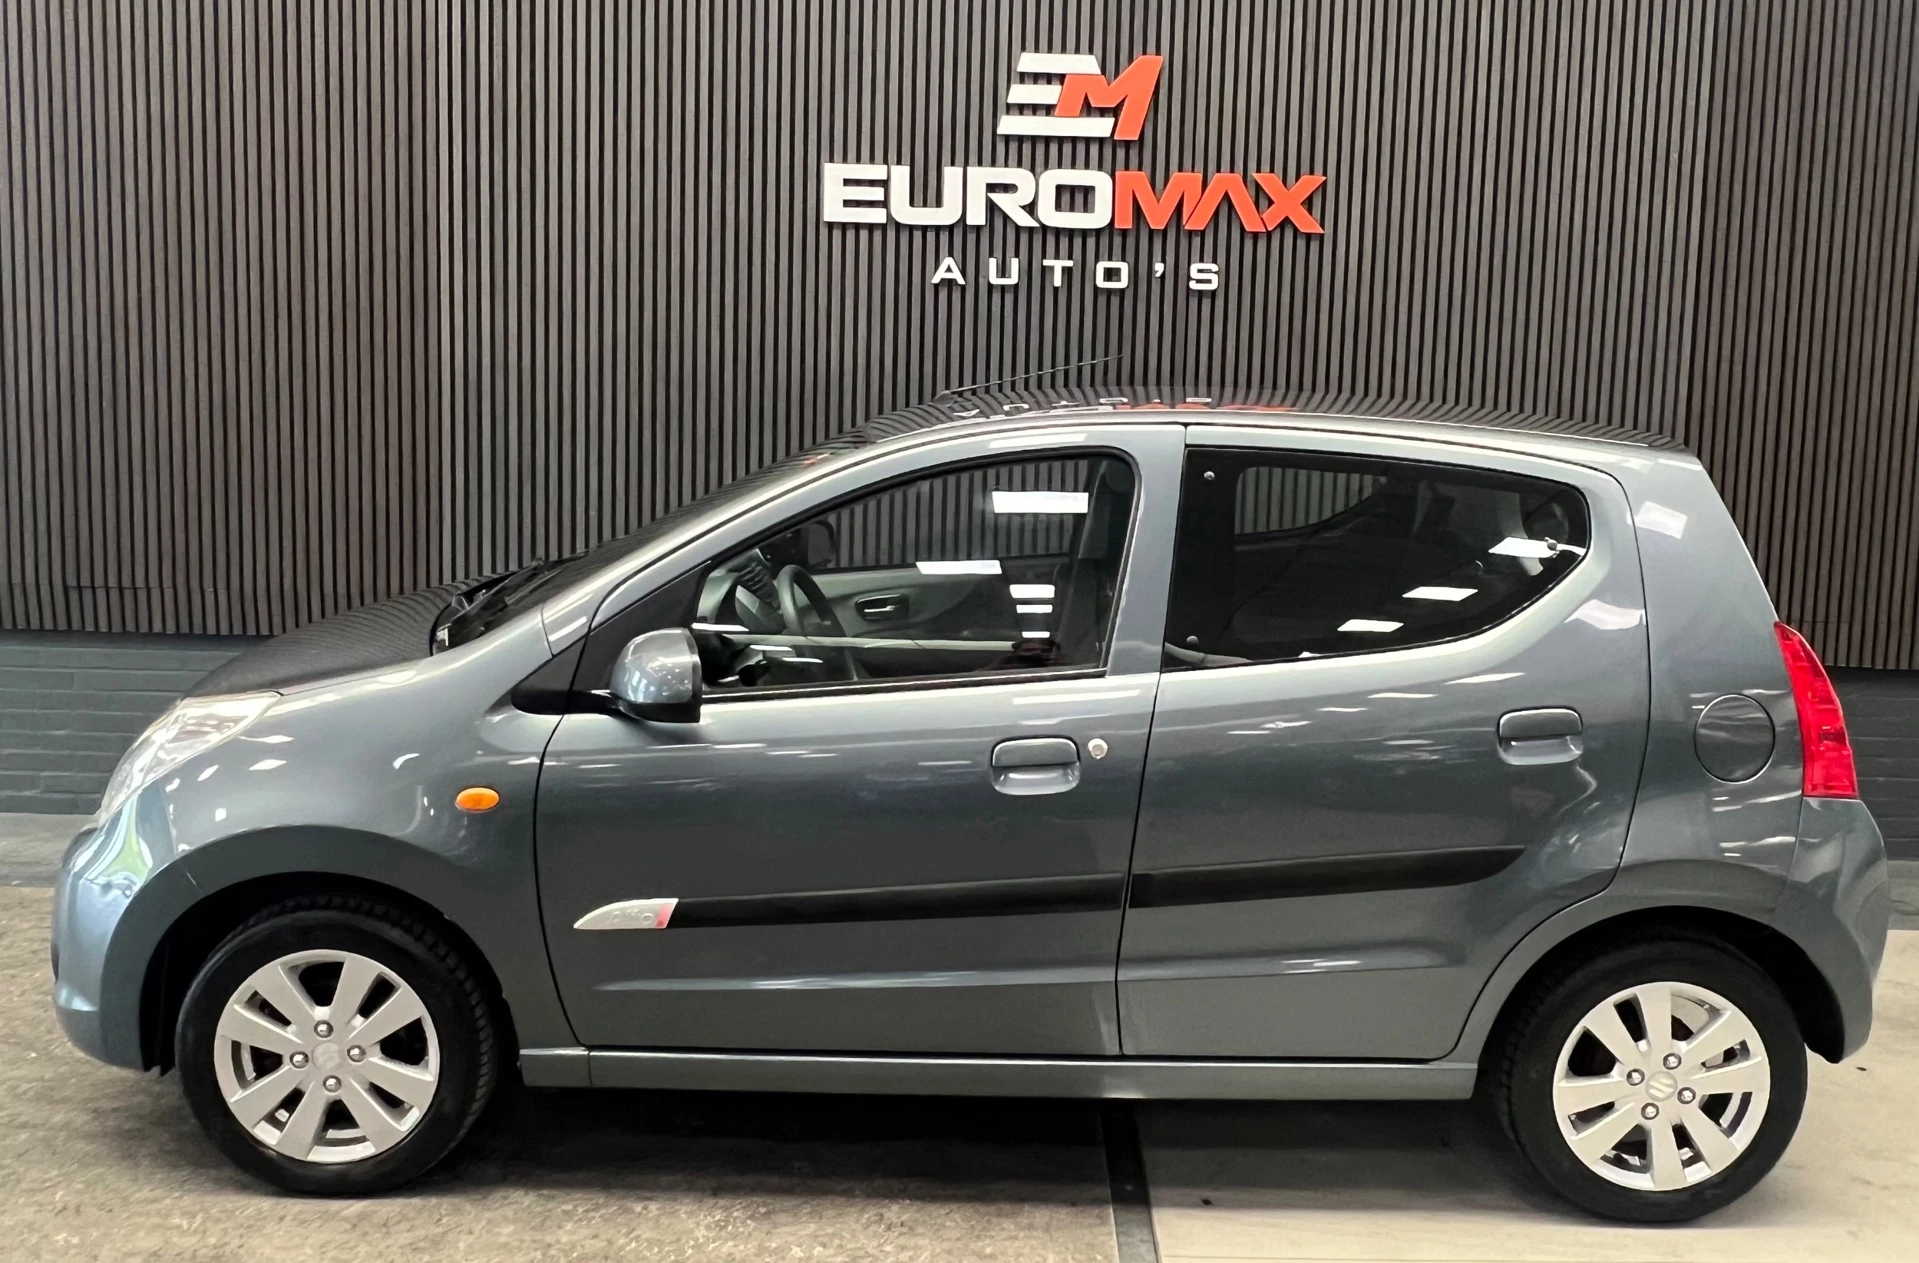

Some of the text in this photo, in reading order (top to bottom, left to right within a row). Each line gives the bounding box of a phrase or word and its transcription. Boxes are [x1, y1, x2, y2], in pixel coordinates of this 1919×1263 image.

[997, 52, 1164, 140] EM
[823, 162, 1327, 233] EUROMAX
[931, 256, 1219, 290] AUTO'S
